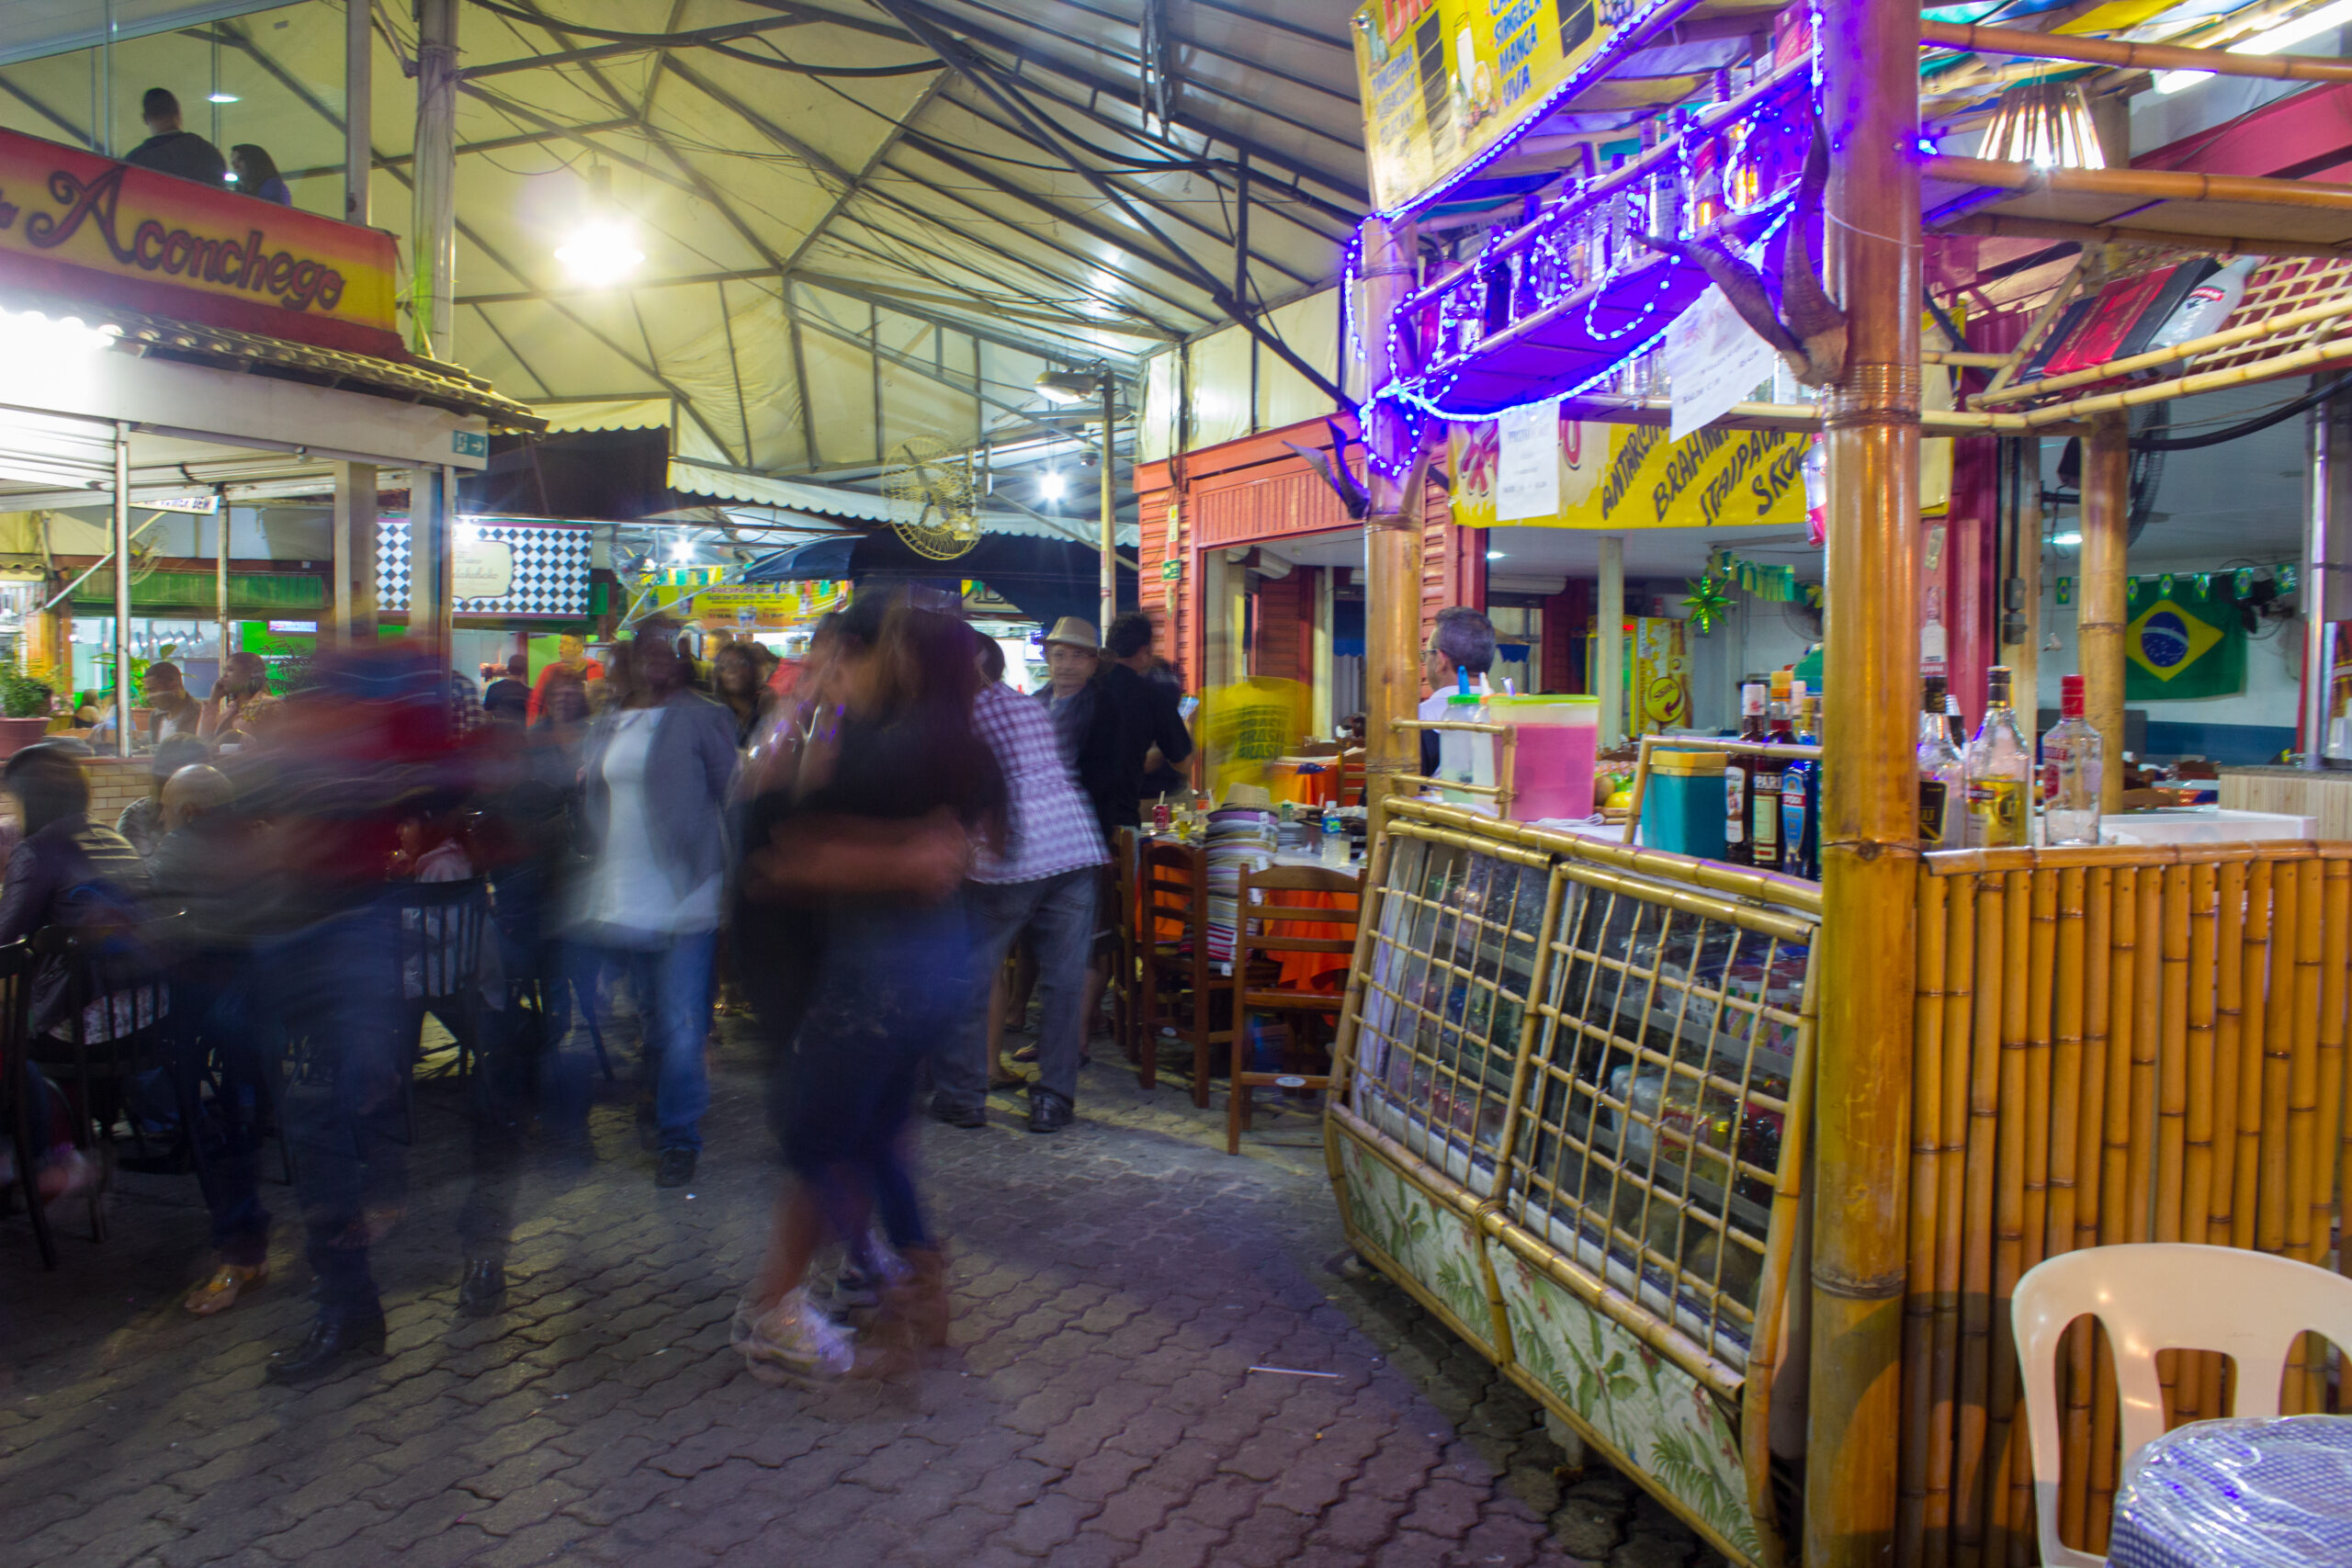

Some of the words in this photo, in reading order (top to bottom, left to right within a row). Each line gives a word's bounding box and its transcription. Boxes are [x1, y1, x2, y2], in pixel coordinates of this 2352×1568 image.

[1498, 22, 1538, 79] MANGA
[1503, 63, 1532, 107] UVA
[26, 164, 345, 311] Aconchego
[1601, 424, 1668, 521] ANTARC
[1752, 433, 1808, 516] SKOL
